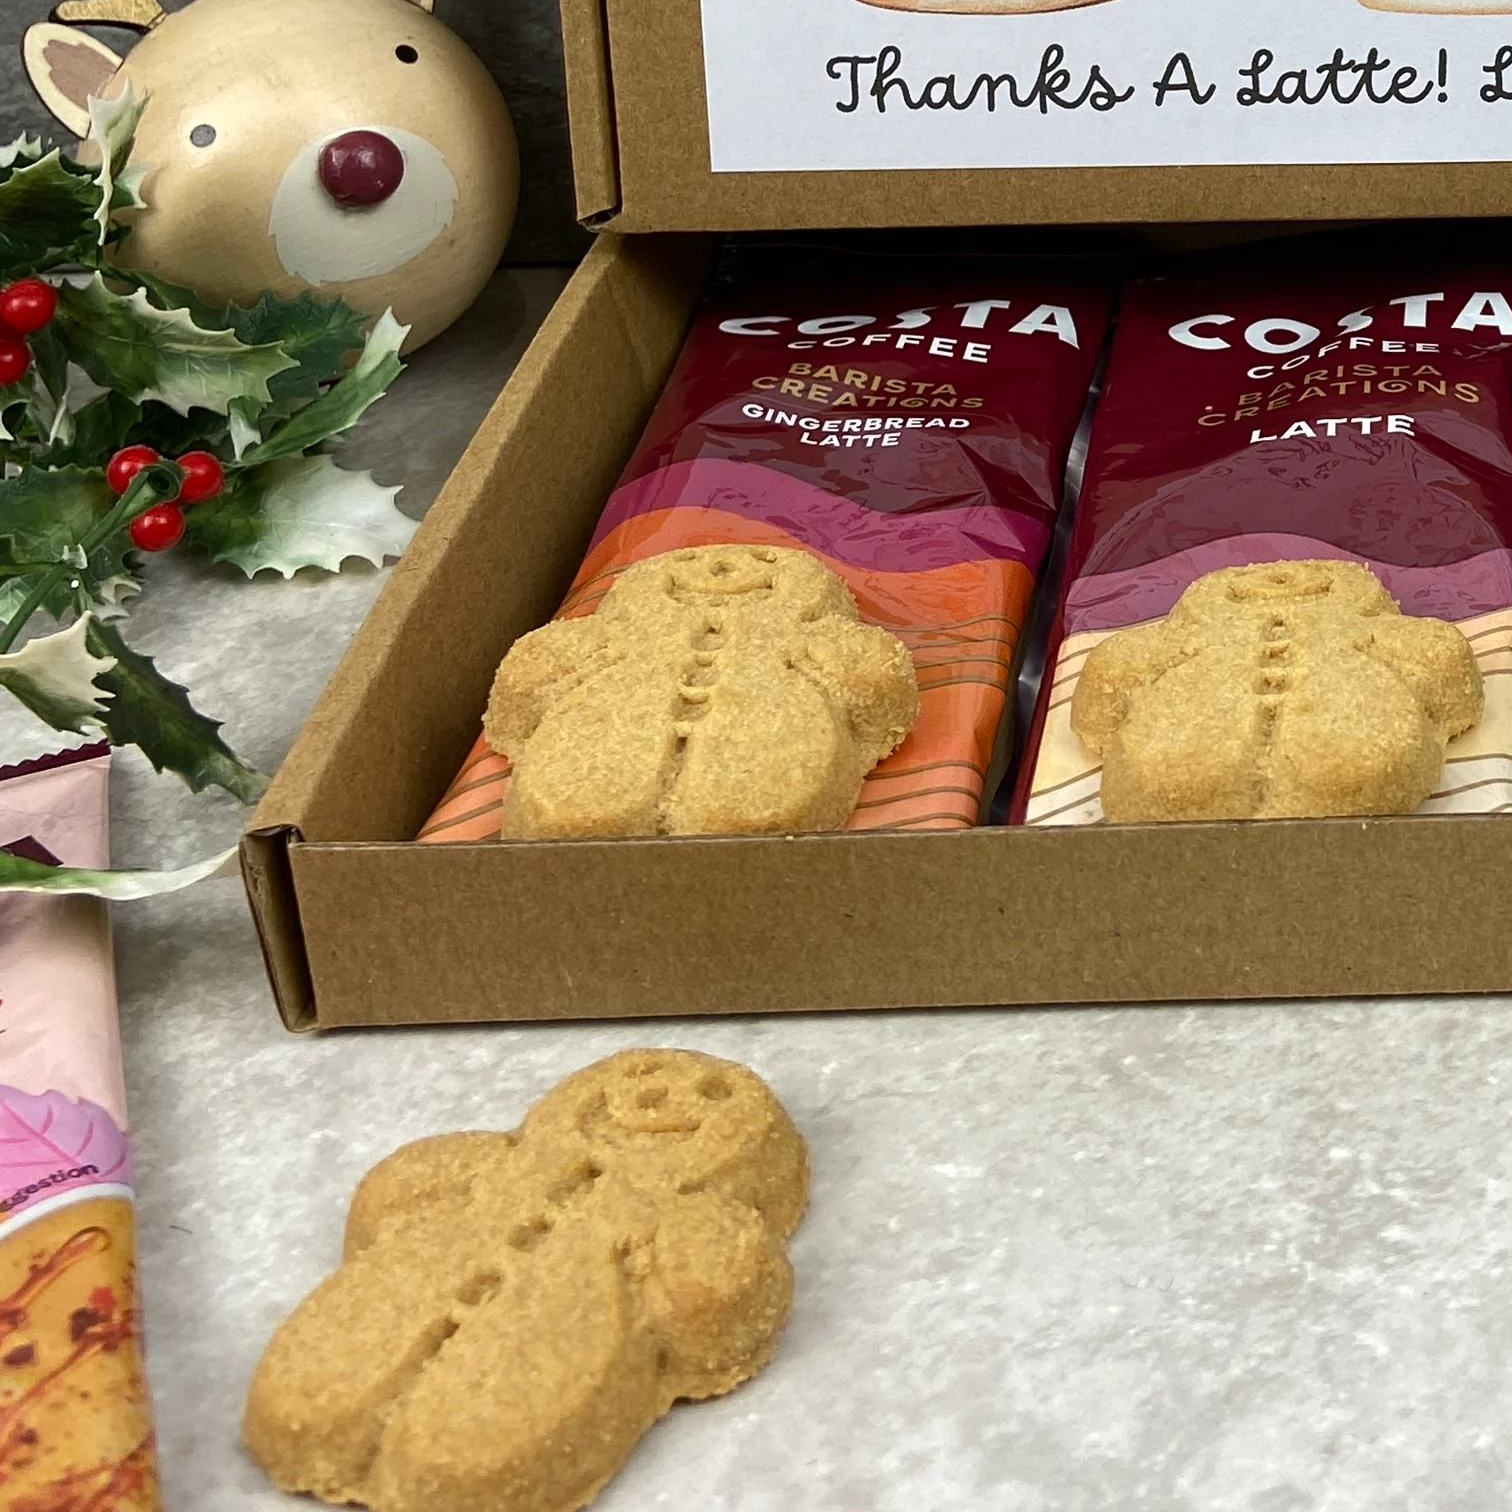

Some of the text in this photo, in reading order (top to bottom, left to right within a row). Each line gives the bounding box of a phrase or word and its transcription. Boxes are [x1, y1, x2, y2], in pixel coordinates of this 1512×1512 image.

[826, 43, 1135, 115] Thanks
[1152, 52, 1217, 107] A
[1236, 47, 1450, 107] Latte!
[719, 299, 1080, 350] COSTA
[787, 333, 992, 363] COFFEE
[1247, 336, 1440, 379] COFFEE
[752, 376, 984, 408] CREATIONS
[788, 362, 957, 396] BARISTA
[1238, 364, 1442, 406] BARISTA
[742, 403, 970, 432] GINGERBREAD
[1197, 379, 1480, 426] CREATIONS
[800, 431, 900, 448] LATTE
[1250, 414, 1415, 443] LATTE
